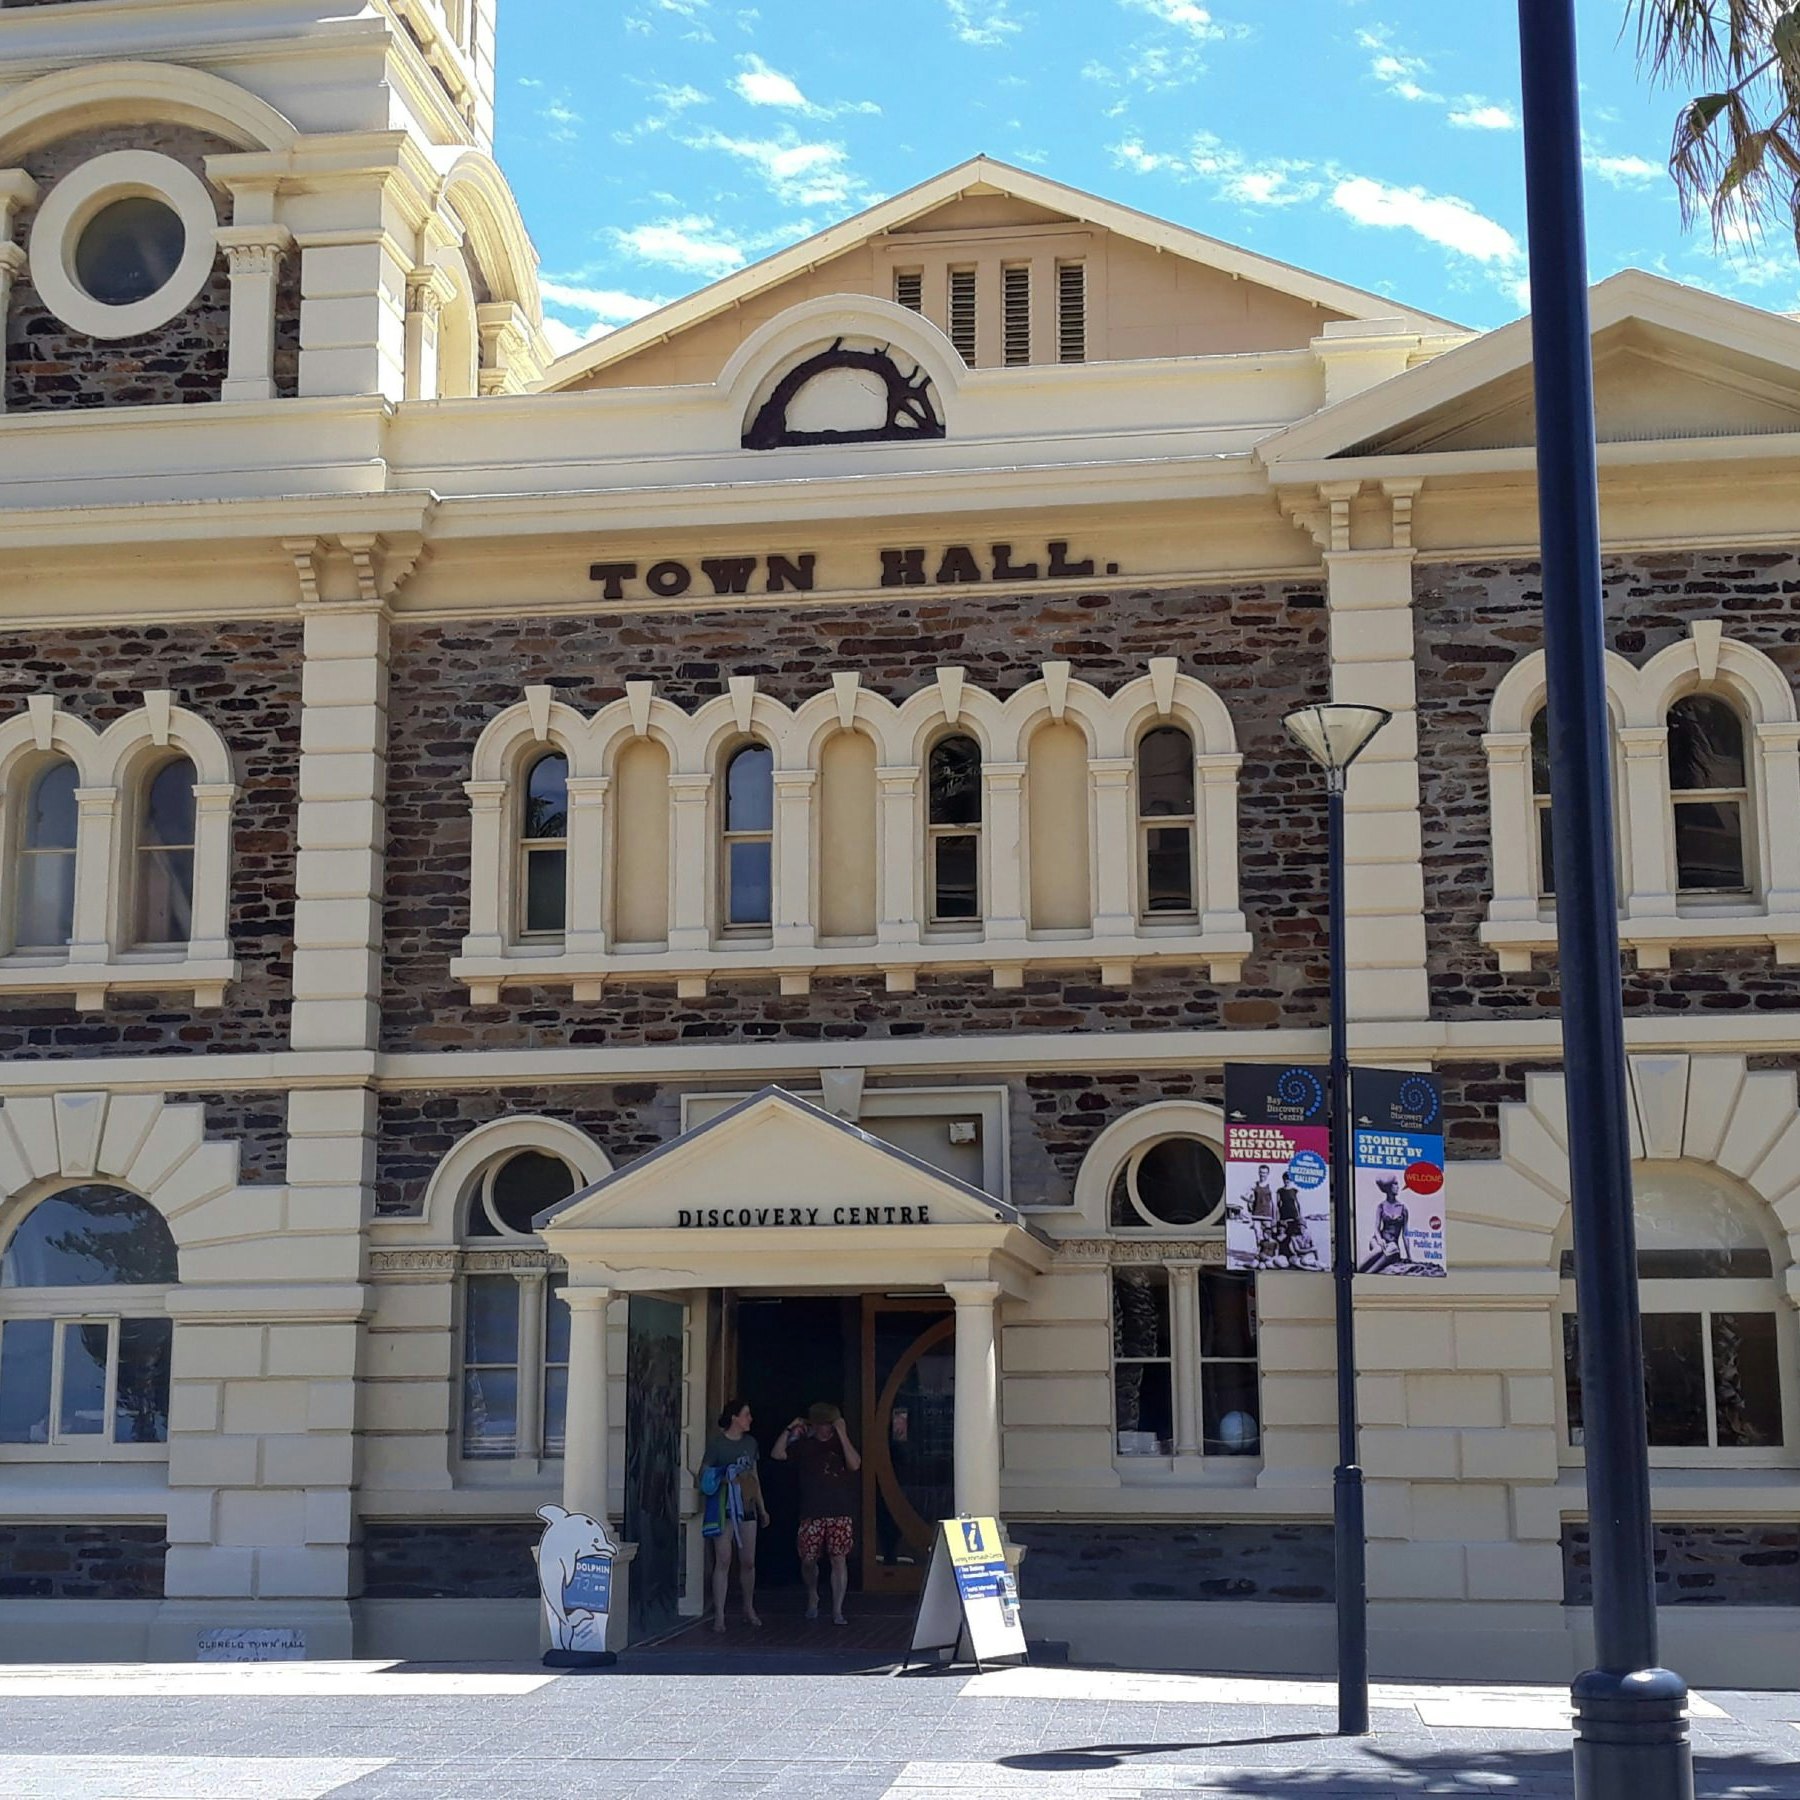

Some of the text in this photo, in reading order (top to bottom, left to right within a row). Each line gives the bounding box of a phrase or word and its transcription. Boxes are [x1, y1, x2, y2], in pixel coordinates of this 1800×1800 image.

[590, 554, 816, 600] TOWN
[1267, 1095, 1281, 1105] Bay
[1267, 1104, 1304, 1114] Discovery
[1390, 1103, 1403, 1113] Bay
[1278, 1112, 1304, 1121] Centre
[1390, 1111, 1423, 1122] Discovery
[1400, 1120, 1423, 1129] Centre
[1229, 1128, 1284, 1139] SOCIAL
[1229, 1138, 1296, 1149] HISTORY
[1358, 1134, 1408, 1146] STORIES
[1230, 1149, 1295, 1159] MUSEUM
[1359, 1144, 1423, 1158] OF LIFE BY
[1359, 1154, 1407, 1166] THE SEA
[1294, 1174, 1319, 1184] GALLERY
[1405, 1173, 1443, 1183] WELCOME
[678, 1205, 930, 1228] DISCOVERY CENTRE
[1431, 1231, 1442, 1239] and
[1413, 1239, 1442, 1249] Public Art
[1424, 1250, 1442, 1259] Walks
[576, 1562, 610, 1574] DOLPHIN
[198, 1639, 305, 1649] GLENELG TOWN HALL
